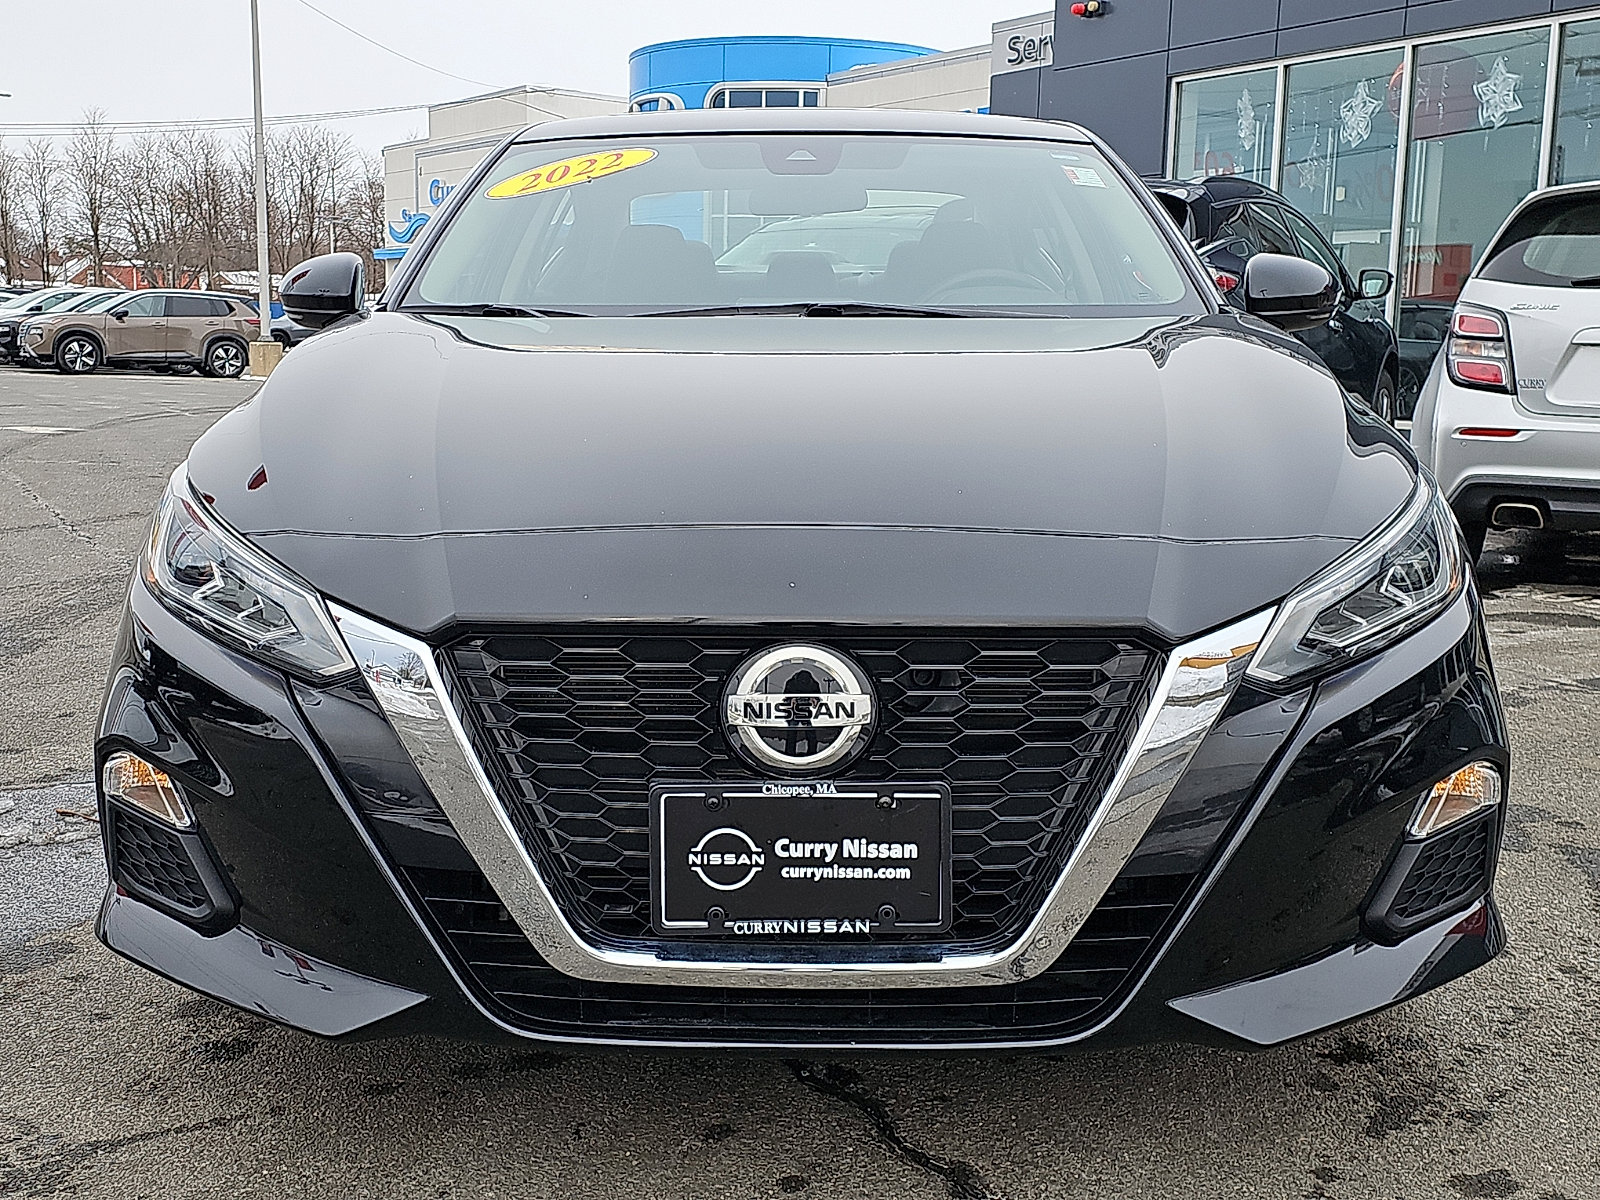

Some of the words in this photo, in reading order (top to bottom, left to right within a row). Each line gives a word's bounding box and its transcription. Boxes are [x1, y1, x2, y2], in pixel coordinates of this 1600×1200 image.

[515, 152, 624, 194] 2022
[429, 178, 457, 206] Cu
[1517, 378, 1547, 387] CURRY
[743, 700, 856, 720] NISSAN
[762, 783, 814, 797] Chicopee,
[816, 783, 837, 794] MA
[688, 853, 765, 866] NISSAN
[774, 838, 838, 863] Curry
[842, 838, 918, 859] Nissan
[781, 864, 911, 882] currynissan.com
